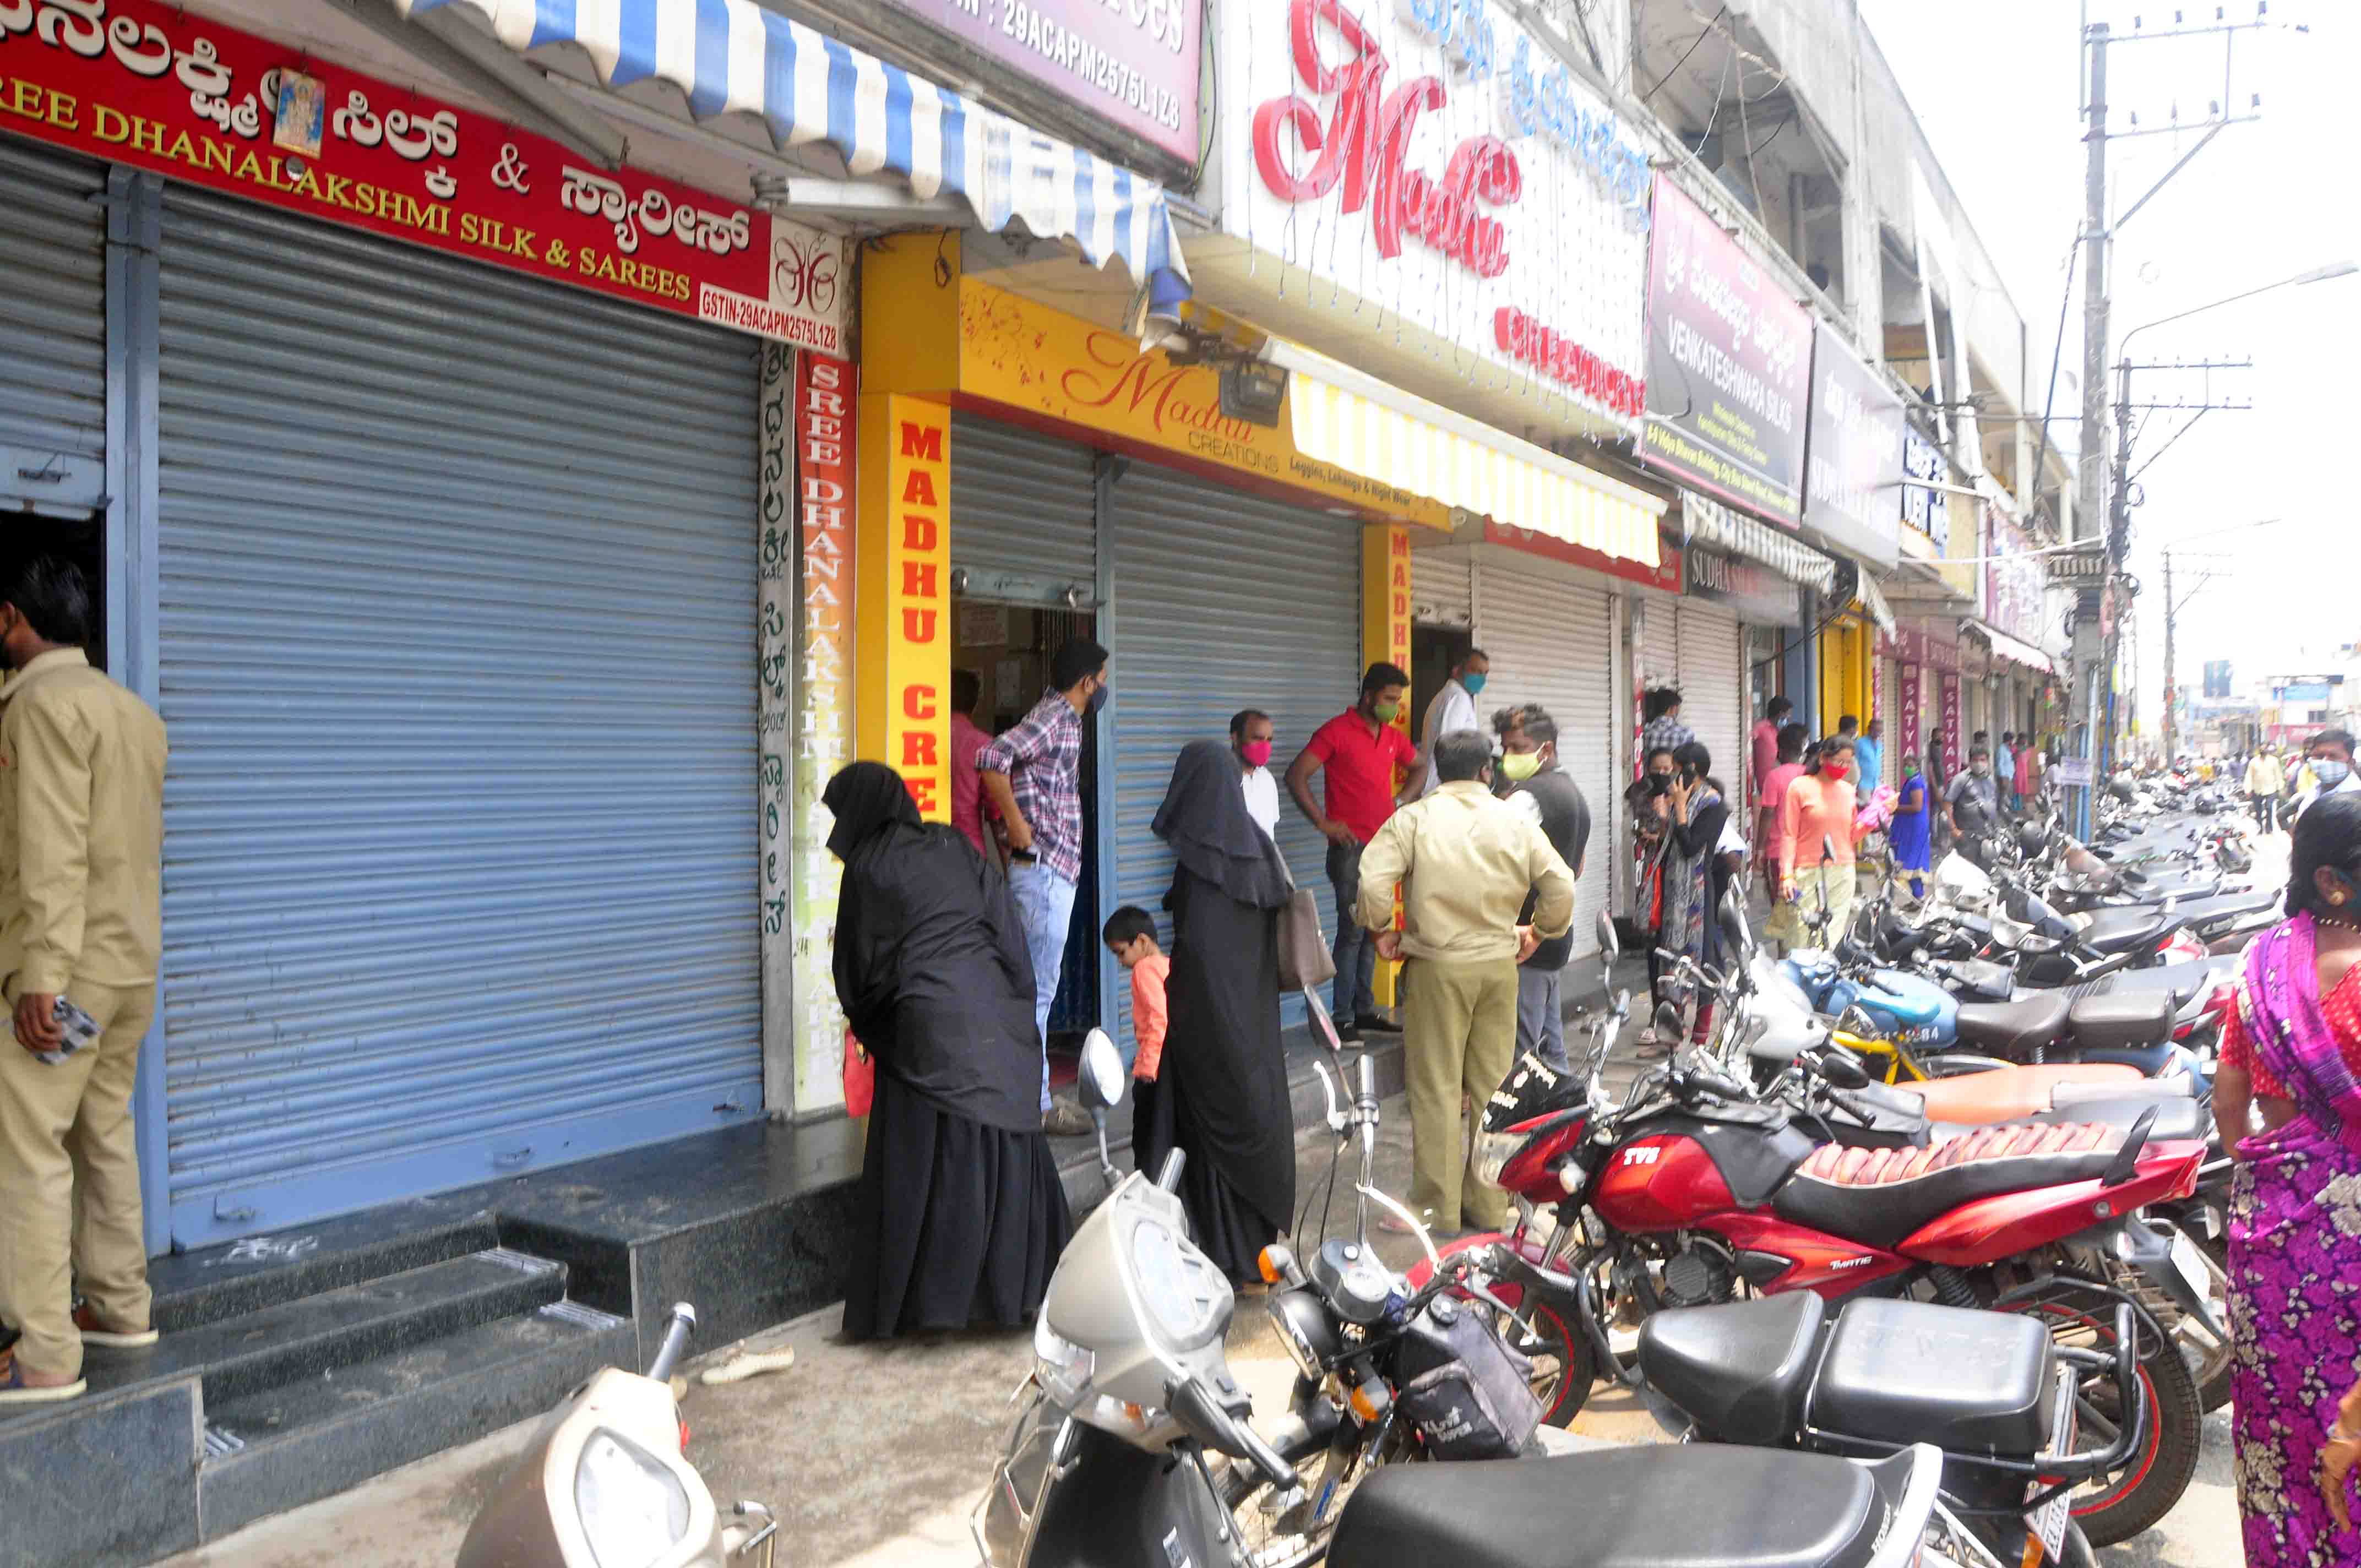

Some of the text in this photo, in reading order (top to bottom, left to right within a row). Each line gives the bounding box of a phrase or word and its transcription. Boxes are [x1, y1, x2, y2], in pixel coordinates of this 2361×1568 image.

[1003, 0, 1180, 131] 29ACAPM2575L1Z8
[92, 103, 450, 236] DHANALAKSHMI
[460, 214, 539, 259] SILK
[546, 239, 570, 269] &
[580, 247, 691, 301] SAREES
[491, 143, 530, 195] &
[702, 292, 837, 350] GSTIN-29ACAPM2575L1Z8
[806, 363, 846, 467] SREE
[1188, 431, 1280, 475] CREATIONS
[901, 422, 942, 644] MADHU
[1623, 1147, 1661, 1166] TVS
